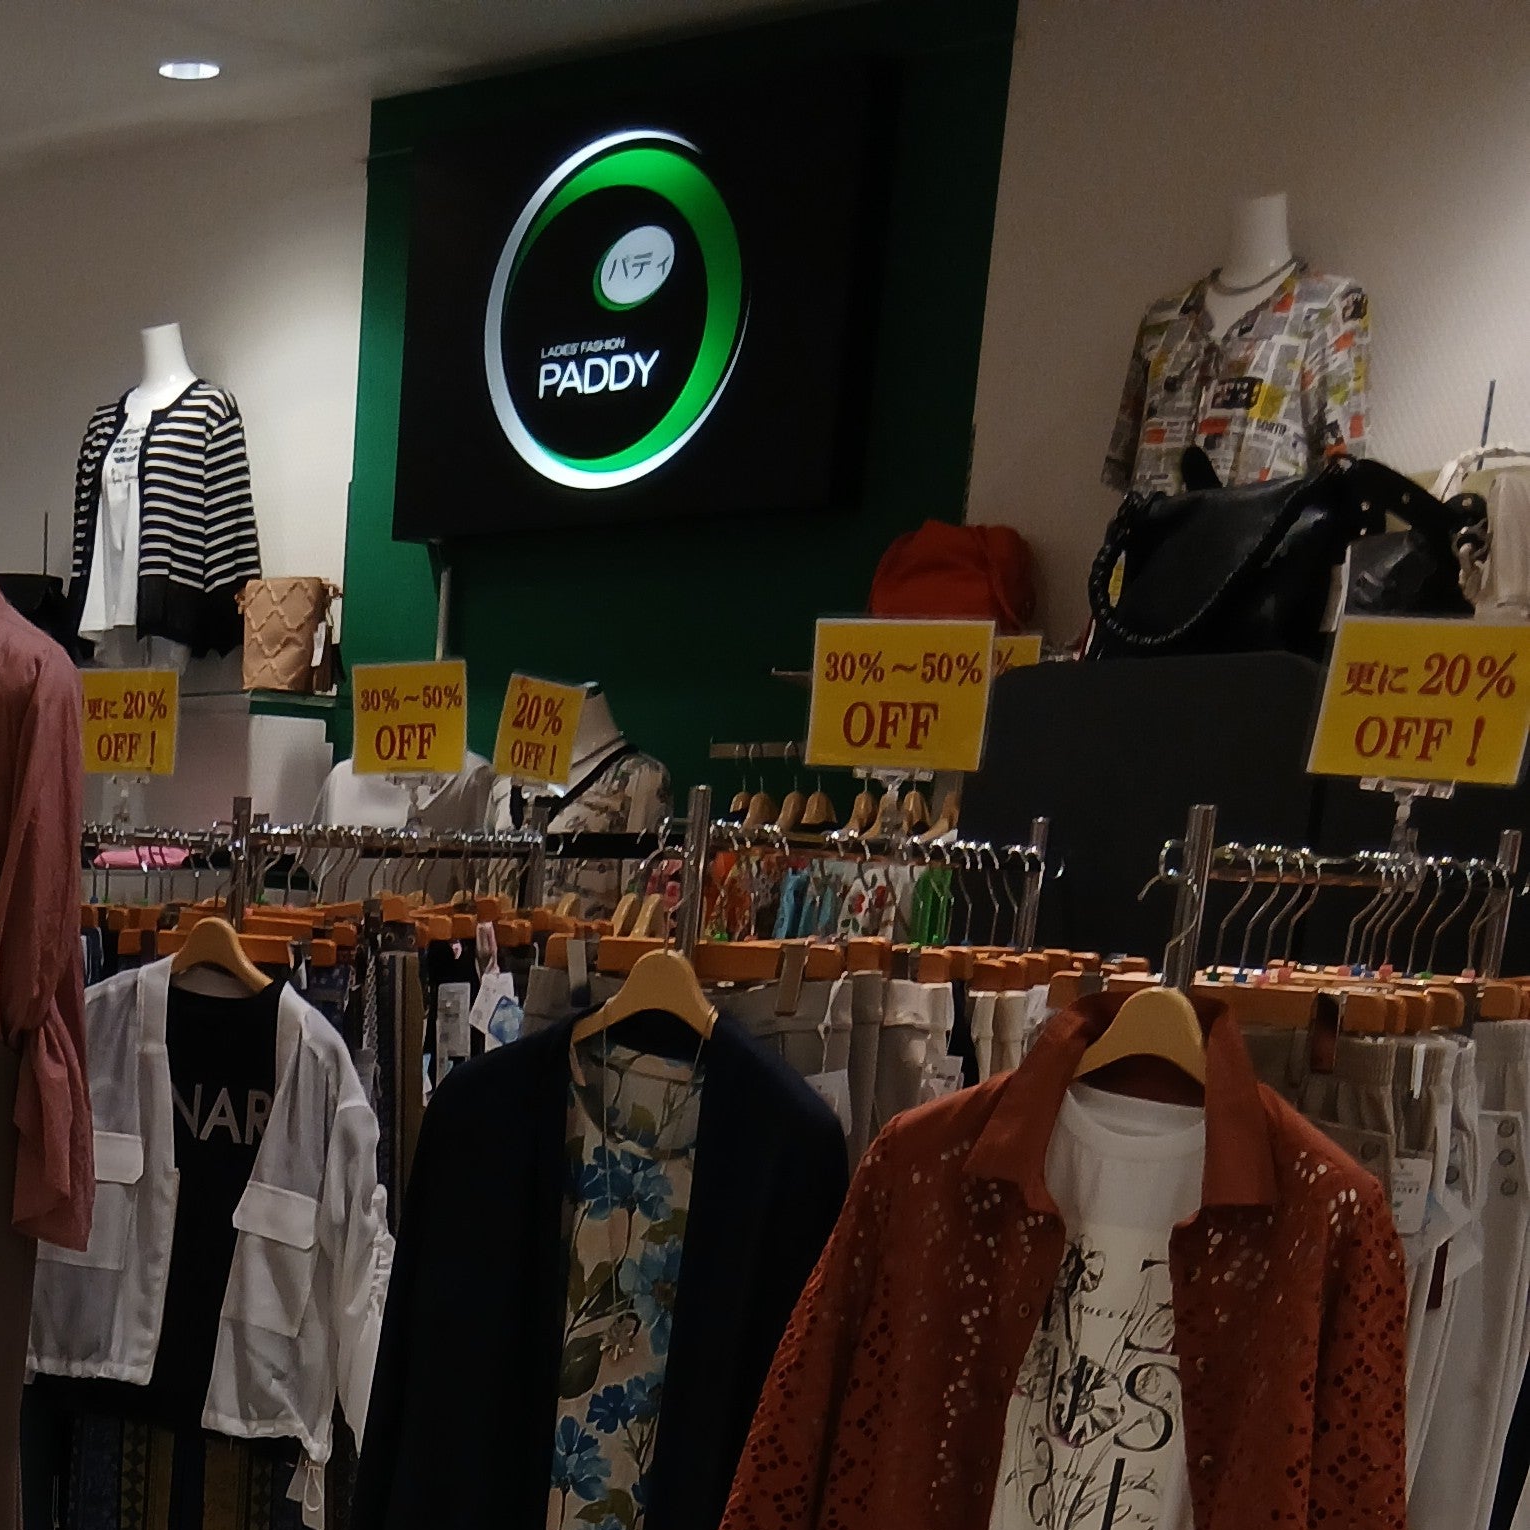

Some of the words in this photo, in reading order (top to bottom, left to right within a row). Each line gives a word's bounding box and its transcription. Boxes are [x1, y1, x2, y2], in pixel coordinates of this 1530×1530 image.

[538, 349, 660, 399] PADDY
[1417, 651, 1518, 702] 20%
[123, 687, 168, 722] 20%
[511, 692, 565, 737] 20%
[842, 700, 939, 750] OFF
[375, 722, 437, 761] OFF
